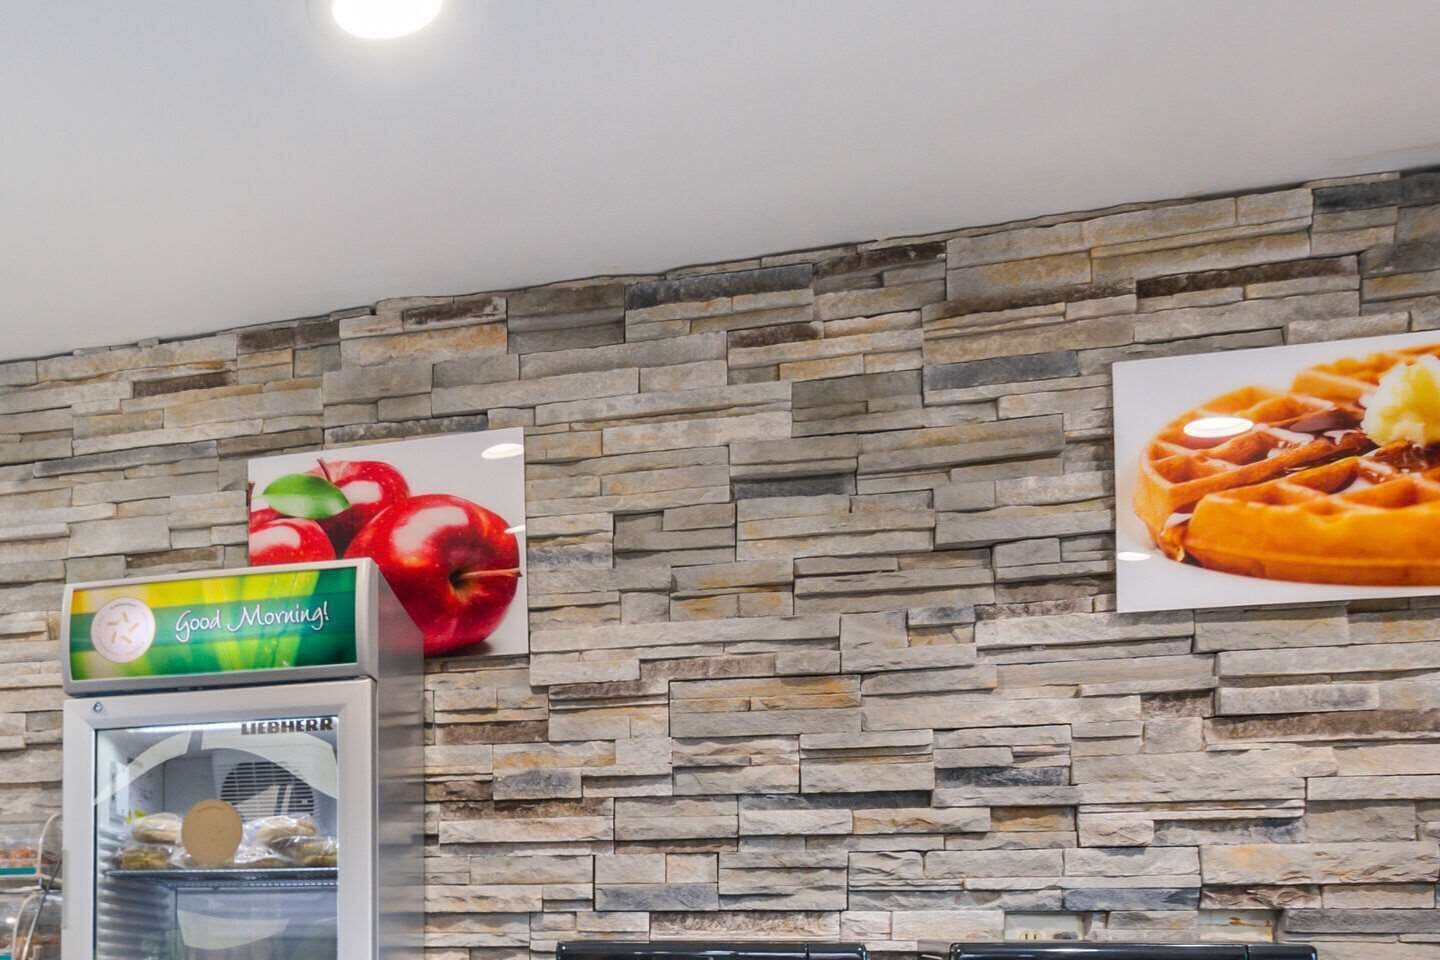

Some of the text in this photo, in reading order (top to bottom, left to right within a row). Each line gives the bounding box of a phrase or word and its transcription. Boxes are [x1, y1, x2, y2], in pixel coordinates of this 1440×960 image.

[175, 600, 330, 642] Good Morning!
[241, 717, 334, 736] LIEBHERR
